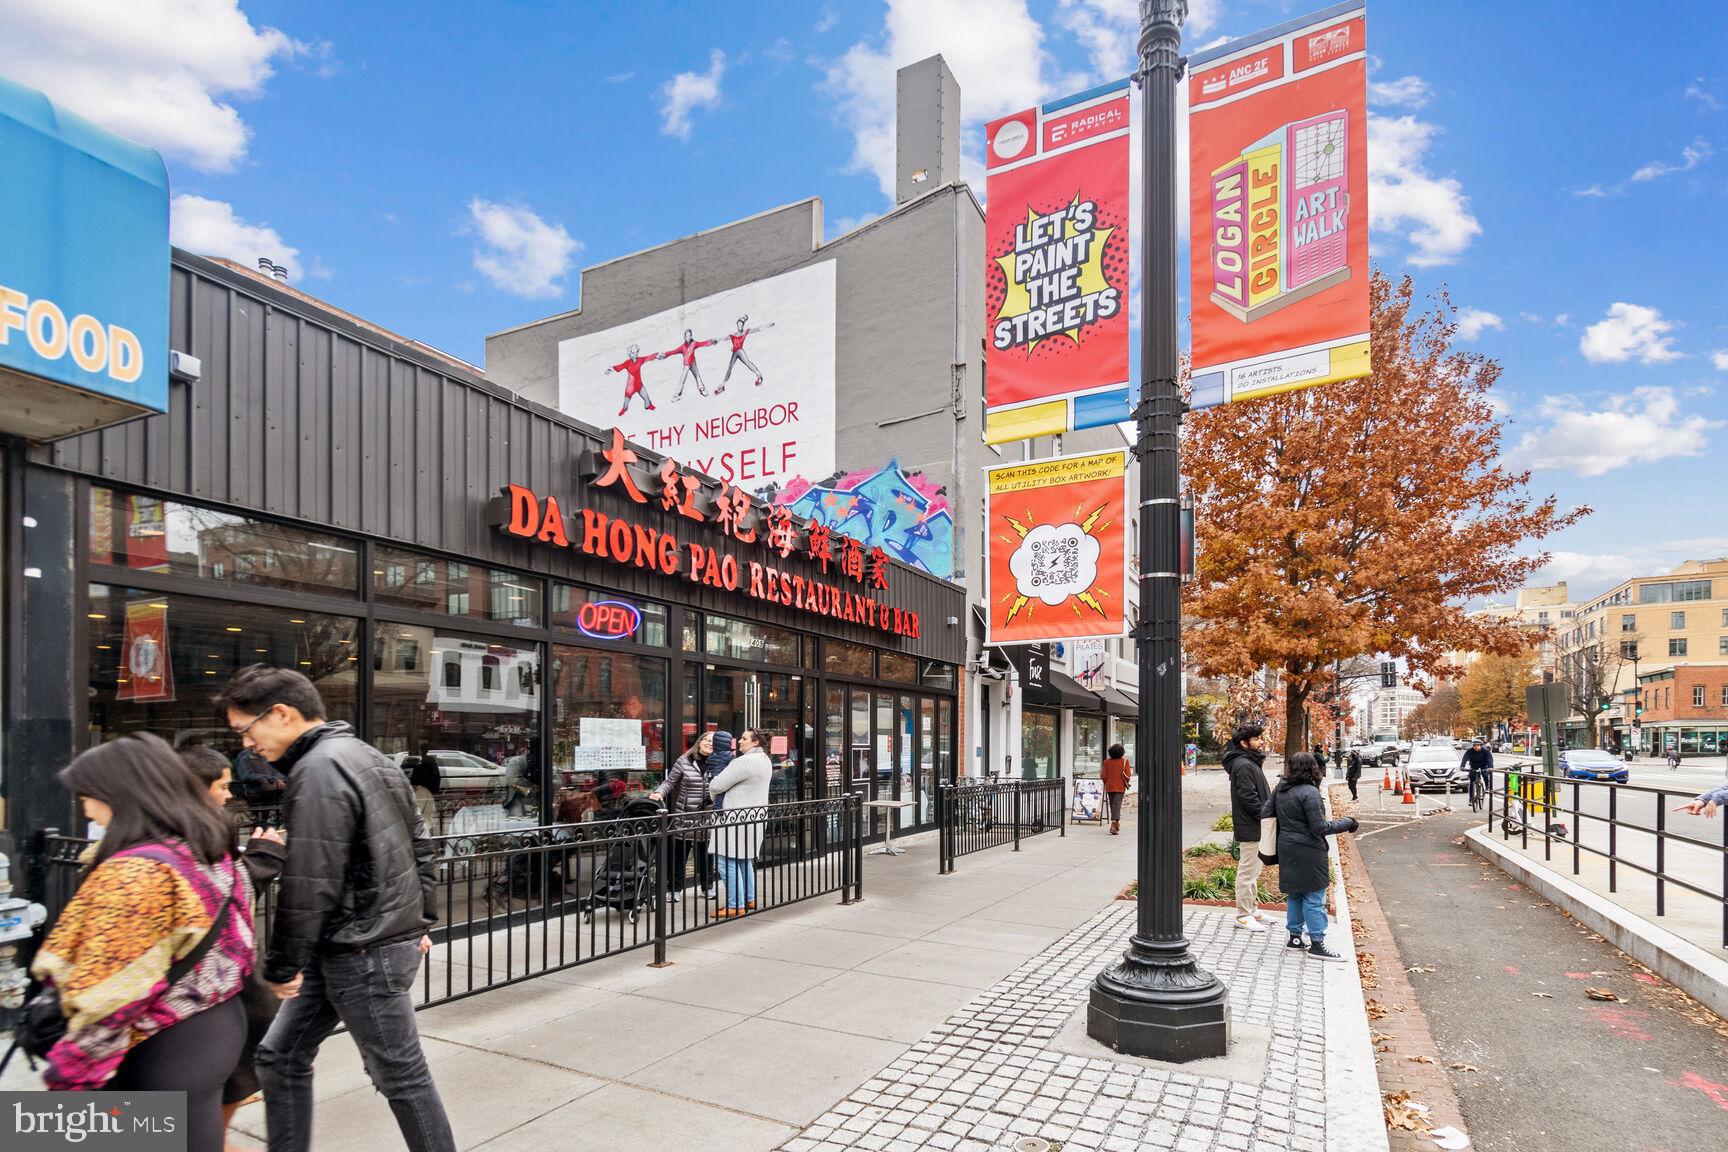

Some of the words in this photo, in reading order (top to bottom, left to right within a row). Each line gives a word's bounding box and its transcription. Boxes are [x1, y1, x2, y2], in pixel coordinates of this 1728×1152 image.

[1229, 63, 1253, 80] ANC
[1254, 58, 1269, 71] 2F
[1071, 109, 1122, 130] RADICAL
[1295, 186, 1341, 223] ART
[1015, 201, 1094, 253] LET'S
[1215, 171, 1244, 301] LOGAN
[1251, 163, 1278, 296] CIRCLE
[1293, 208, 1345, 249] WALK
[1015, 232, 1091, 283] PAINT
[1026, 266, 1078, 309] THE
[0, 285, 144, 383] FOOD
[994, 288, 1117, 349] STREETS
[1248, 365, 1283, 378] ARTISTS
[1251, 367, 1318, 386] INSTALLATIONS
[647, 424, 685, 450] THY
[695, 402, 799, 442] NEIGHBOR
[996, 472, 1015, 480] SCAN
[1017, 468, 1036, 476] THIS
[1039, 464, 1059, 473] CODE
[1062, 461, 1078, 470] FOR
[1087, 459, 1103, 467] MAP
[1105, 456, 1117, 464] OF
[1011, 478, 1048, 489] UTILITY
[1050, 476, 1067, 484] BOX
[508, 483, 570, 547] DA
[582, 508, 680, 575] HONG
[690, 543, 739, 592] PAO
[749, 560, 876, 627] RESTAURANT
[879, 602, 890, 631] &
[893, 607, 921, 640] BAR
[579, 602, 635, 636] OPEN
[1075, 643, 1104, 651] PILATES
